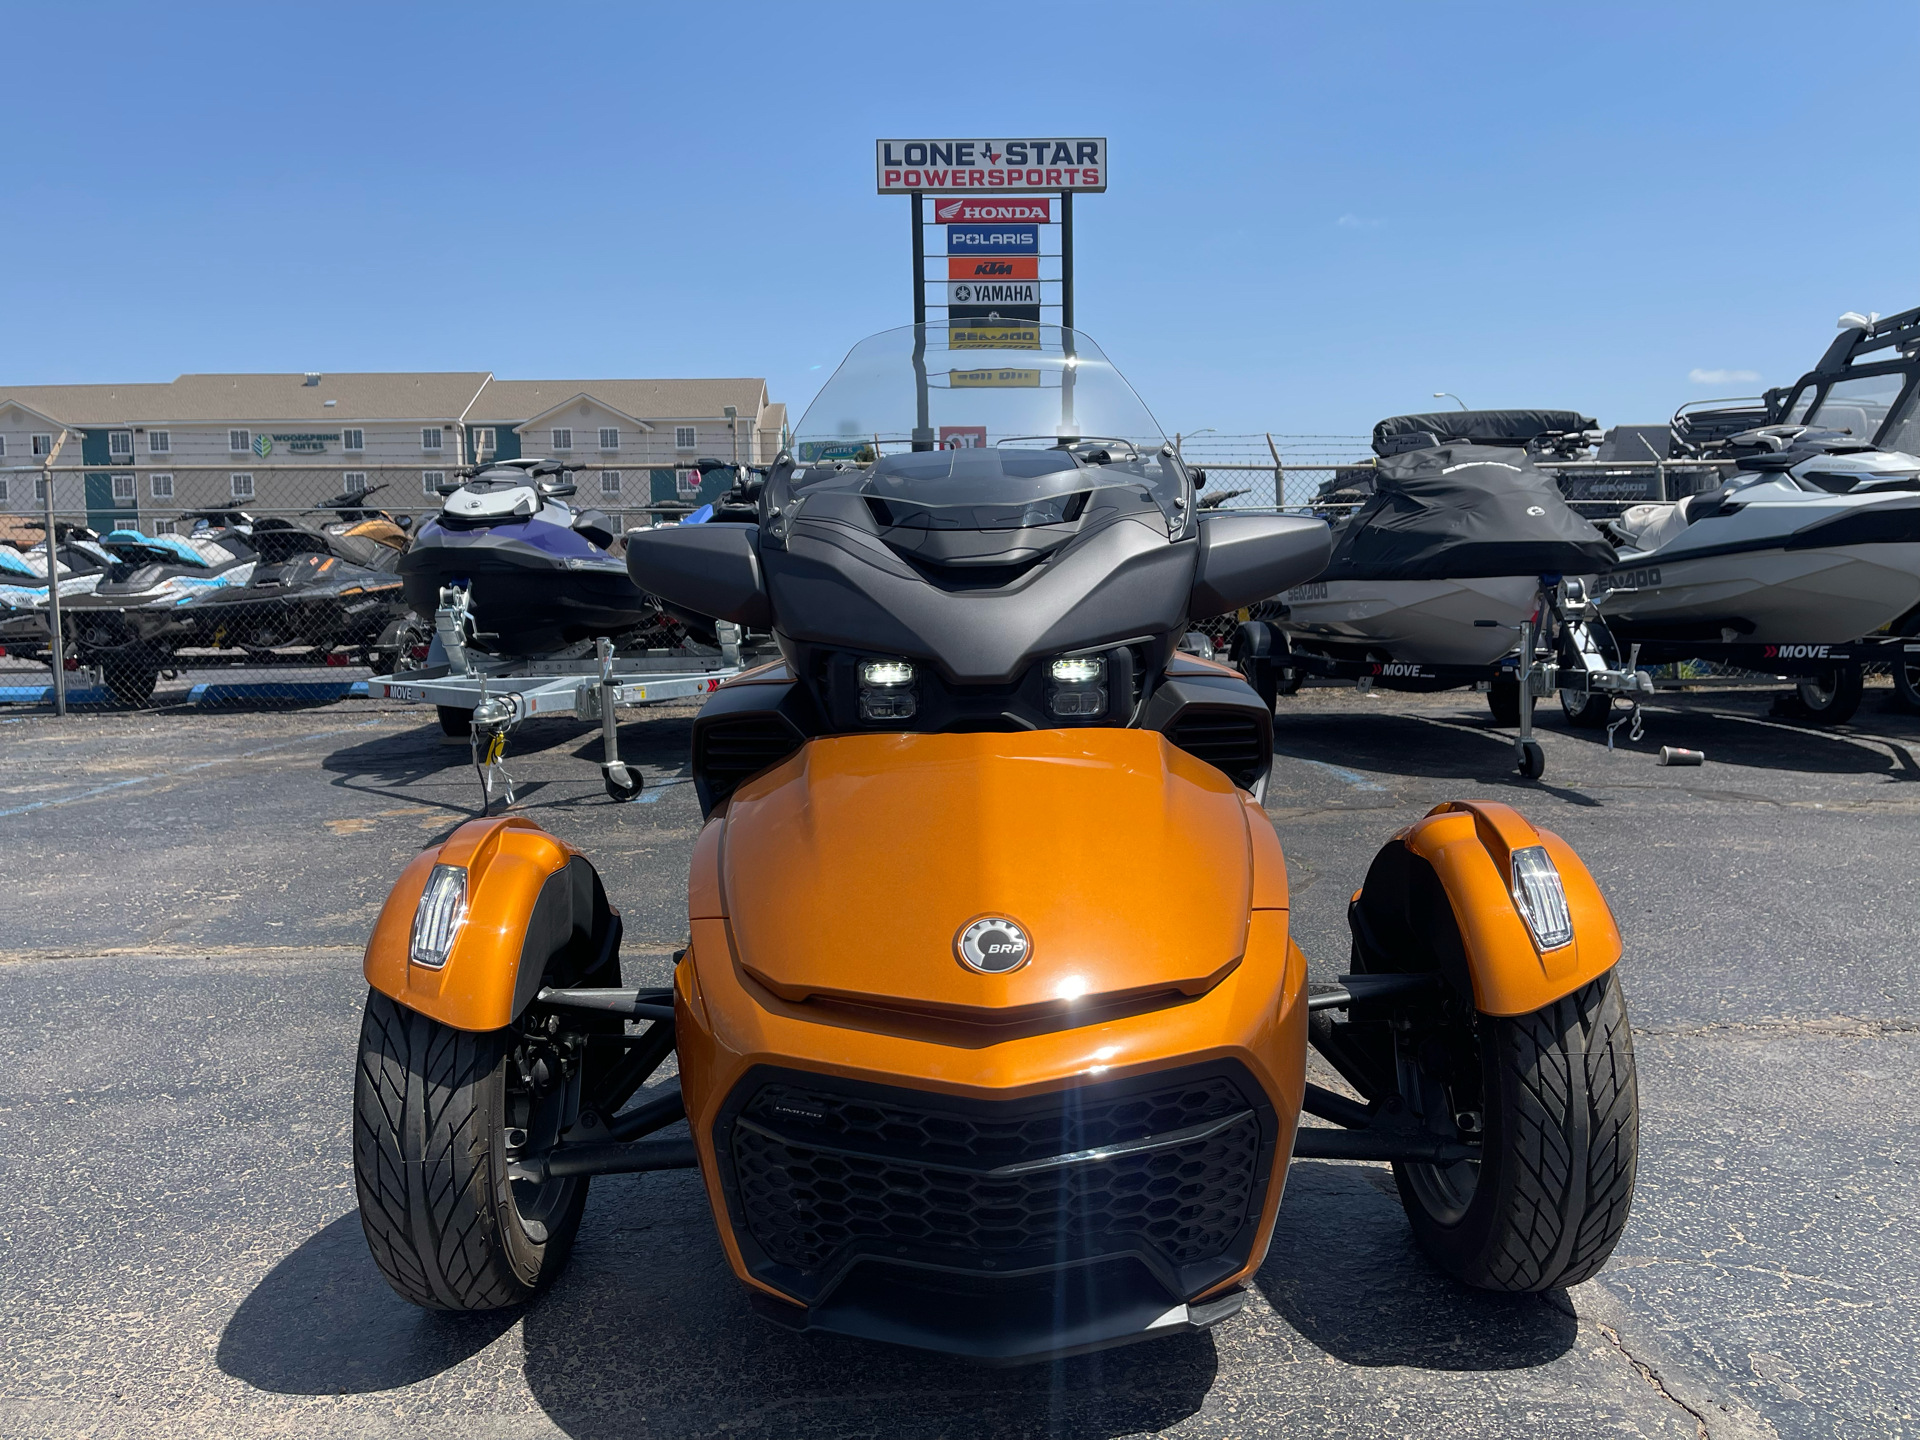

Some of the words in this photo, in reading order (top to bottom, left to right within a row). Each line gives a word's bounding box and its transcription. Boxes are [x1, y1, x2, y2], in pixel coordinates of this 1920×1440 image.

[883, 142, 975, 166] LONE
[1005, 141, 1098, 165] STAR
[884, 168, 1099, 187] POWERSPORTS
[963, 206, 1047, 219] HONDA
[952, 233, 1034, 245] POLARIS
[974, 261, 1013, 275] KTM
[974, 285, 1033, 301] YAMAHA
[272, 433, 340, 442] WOODSPRING
[290, 442, 324, 450] SUITES
[1778, 645, 1830, 658] MOVE
[1382, 664, 1421, 677] MOVE
[390, 686, 412, 700] MOVE
[988, 944, 1024, 953] BRP
[775, 1106, 822, 1118] LIMITED
